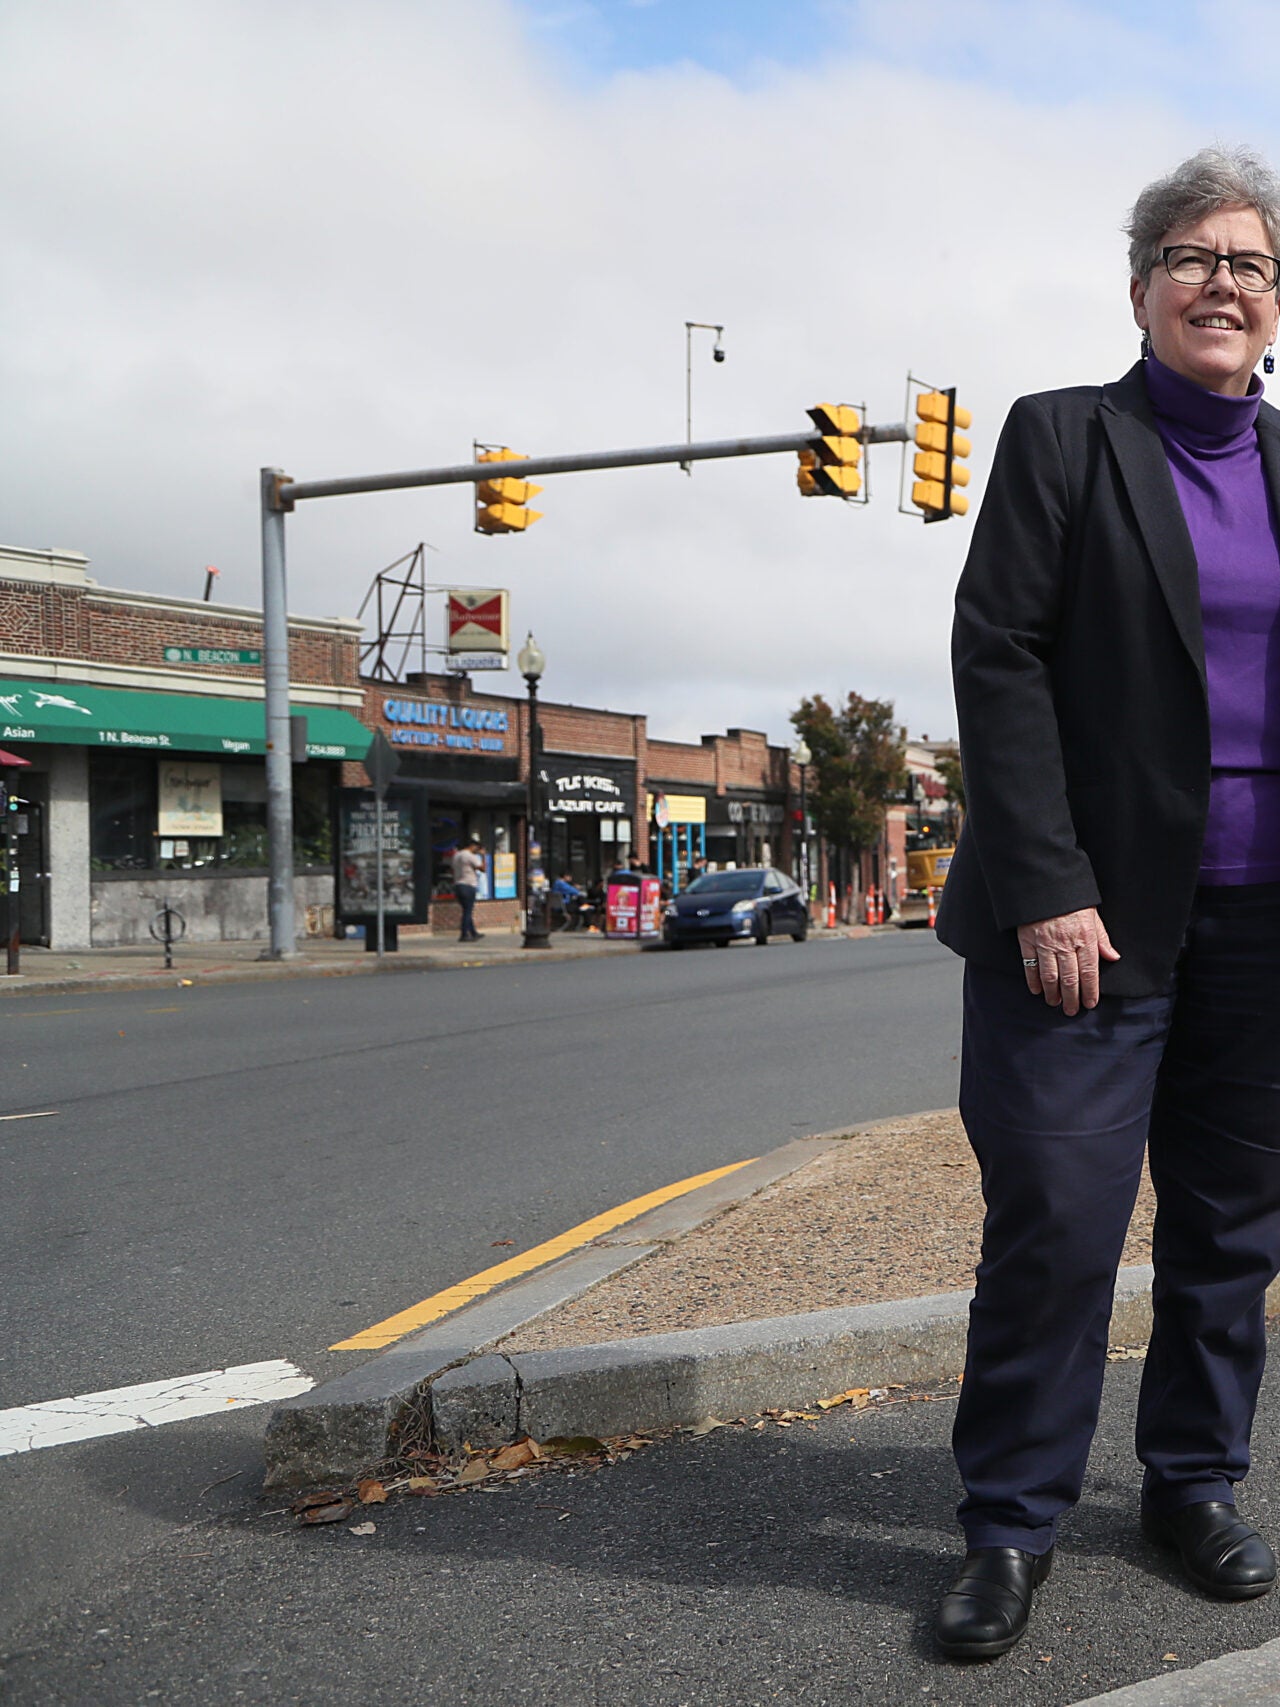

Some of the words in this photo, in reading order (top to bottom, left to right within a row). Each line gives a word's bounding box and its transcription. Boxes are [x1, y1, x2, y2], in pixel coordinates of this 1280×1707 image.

[198, 650, 240, 662] BEACON
[384, 699, 447, 726] QUALITY
[3, 726, 35, 739] Asian
[99, 731, 104, 742] 1
[107, 732, 119, 743] N.
[121, 732, 157, 744] Beacon
[159, 734, 171, 746] St.
[222, 739, 250, 752] Vegan
[595, 801, 625, 812] CAFE
[350, 822, 399, 836] PREVNT
